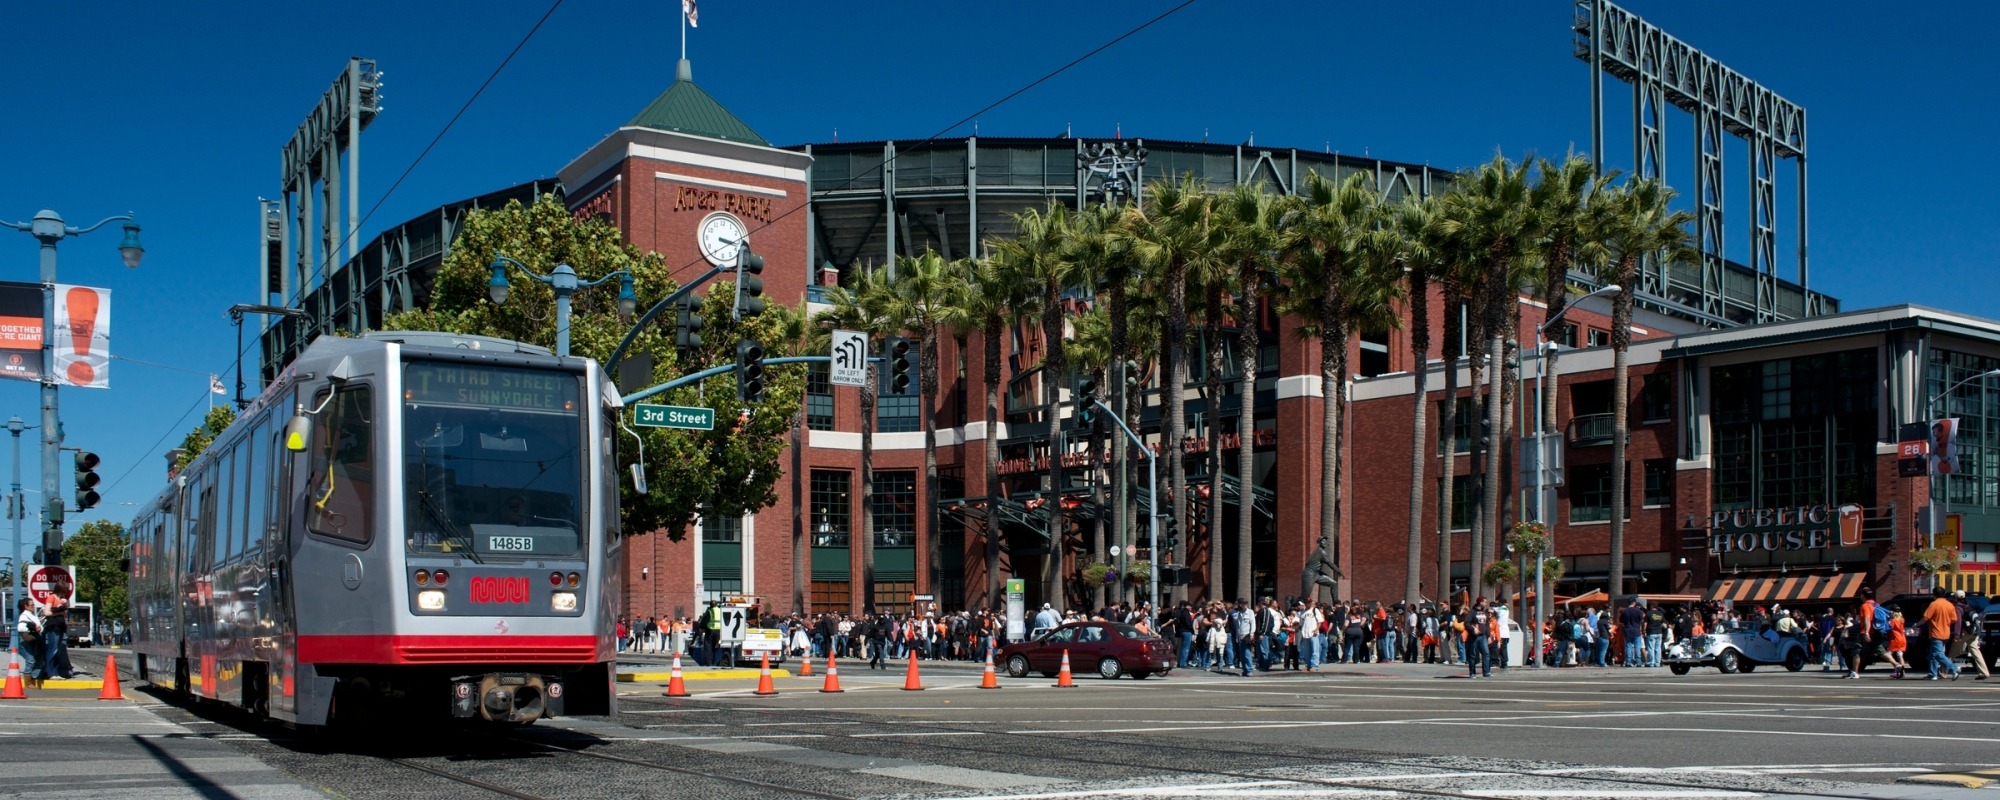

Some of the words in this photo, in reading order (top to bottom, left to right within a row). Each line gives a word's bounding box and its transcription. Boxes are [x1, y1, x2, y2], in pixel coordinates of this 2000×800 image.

[674, 187, 719, 212] AT&T
[725, 194, 771, 225] PARK
[418, 371, 432, 396] T
[437, 370, 489, 386] THIRD
[502, 374, 563, 391] STREET
[458, 388, 553, 408] SUNNYDALE
[642, 409, 664, 422] 3rd
[669, 411, 707, 425] Street
[1904, 444, 1920, 456] 28
[1713, 504, 1829, 530] PUBLIC
[491, 537, 532, 550] 1485B
[1713, 529, 1829, 553] HOUSE
[469, 575, 530, 605] MUNI
